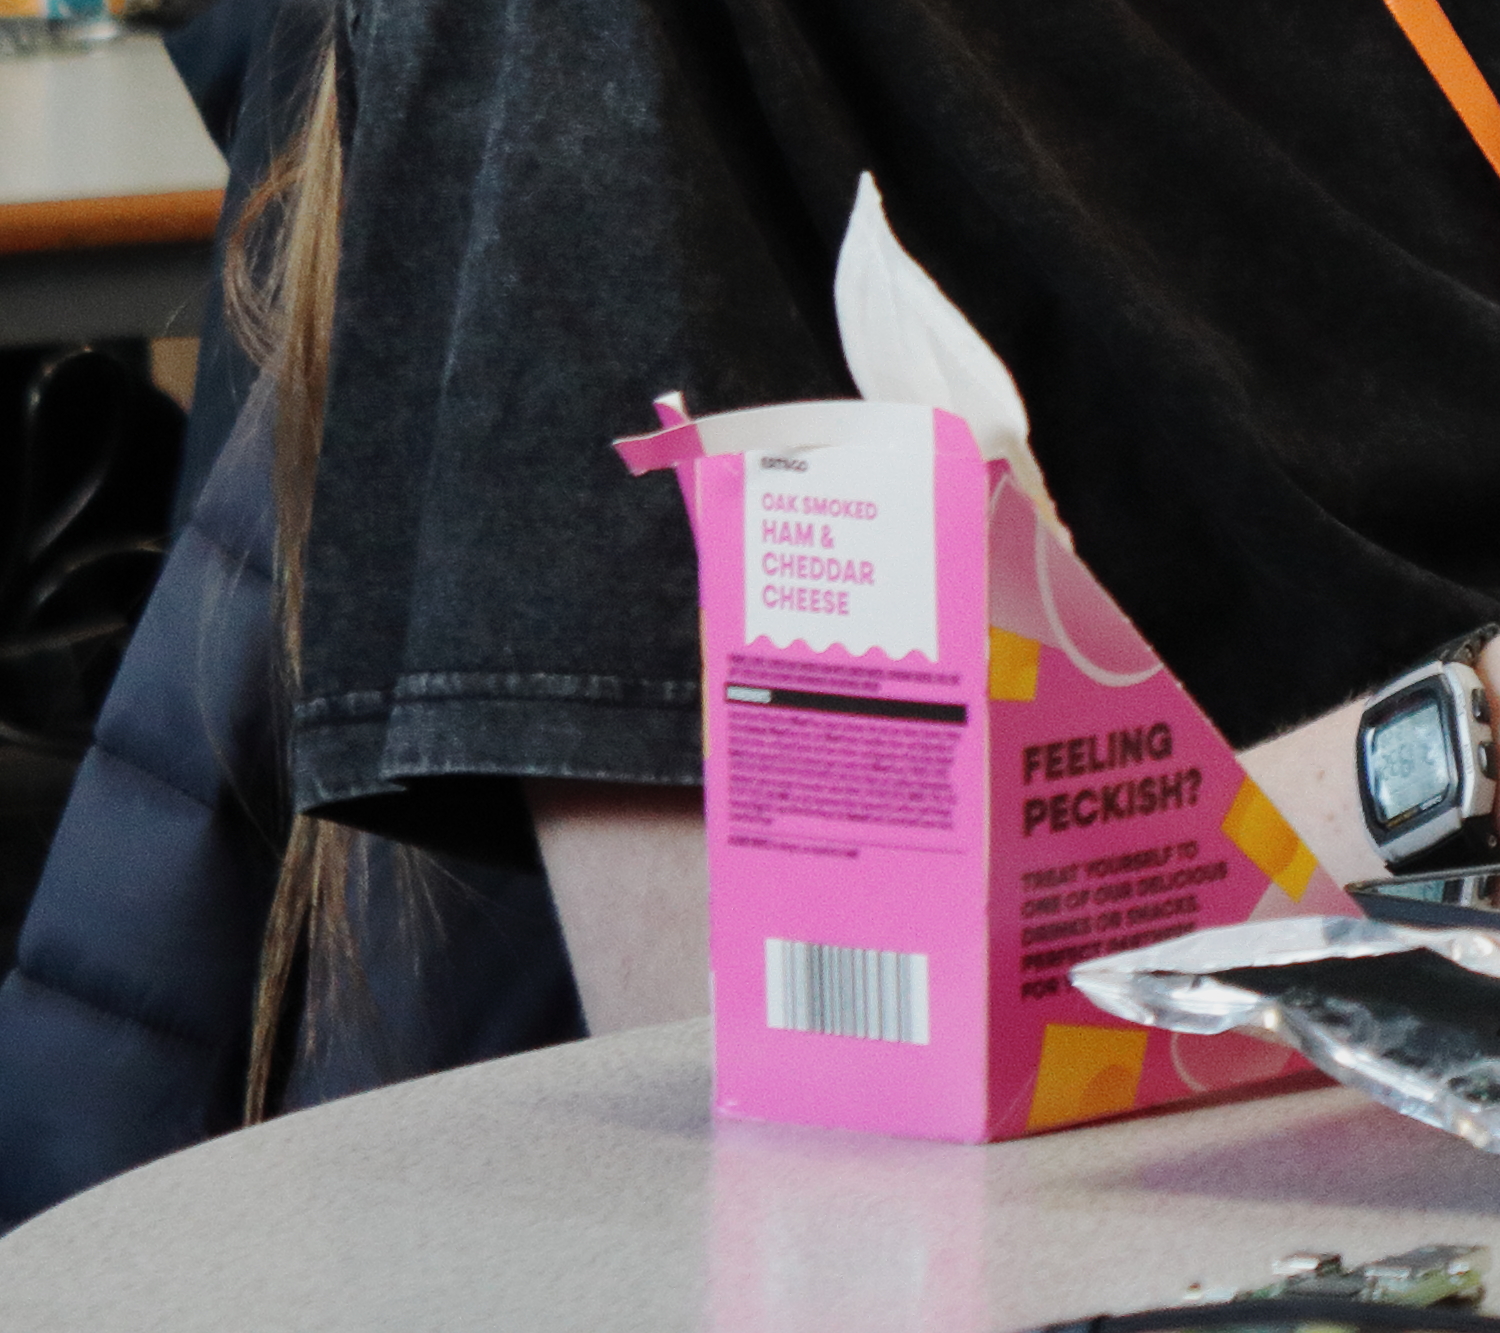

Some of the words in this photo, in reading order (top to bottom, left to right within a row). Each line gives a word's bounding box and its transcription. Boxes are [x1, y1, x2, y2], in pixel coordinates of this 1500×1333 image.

[761, 492, 799, 513] OAK
[802, 496, 878, 521] SMOKED
[761, 519, 815, 548] HAM
[820, 524, 835, 549] &
[761, 551, 875, 586] CHEDDAR
[761, 584, 850, 616] CHEESE
[1022, 722, 1174, 786] FEELING
[1022, 767, 1203, 838] PECKISH?
[1084, 846, 1175, 878] YOURSELF
[1176, 840, 1198, 860] TO
[1021, 895, 1061, 919] ONE
[1136, 860, 1228, 898] DELICIOUS
